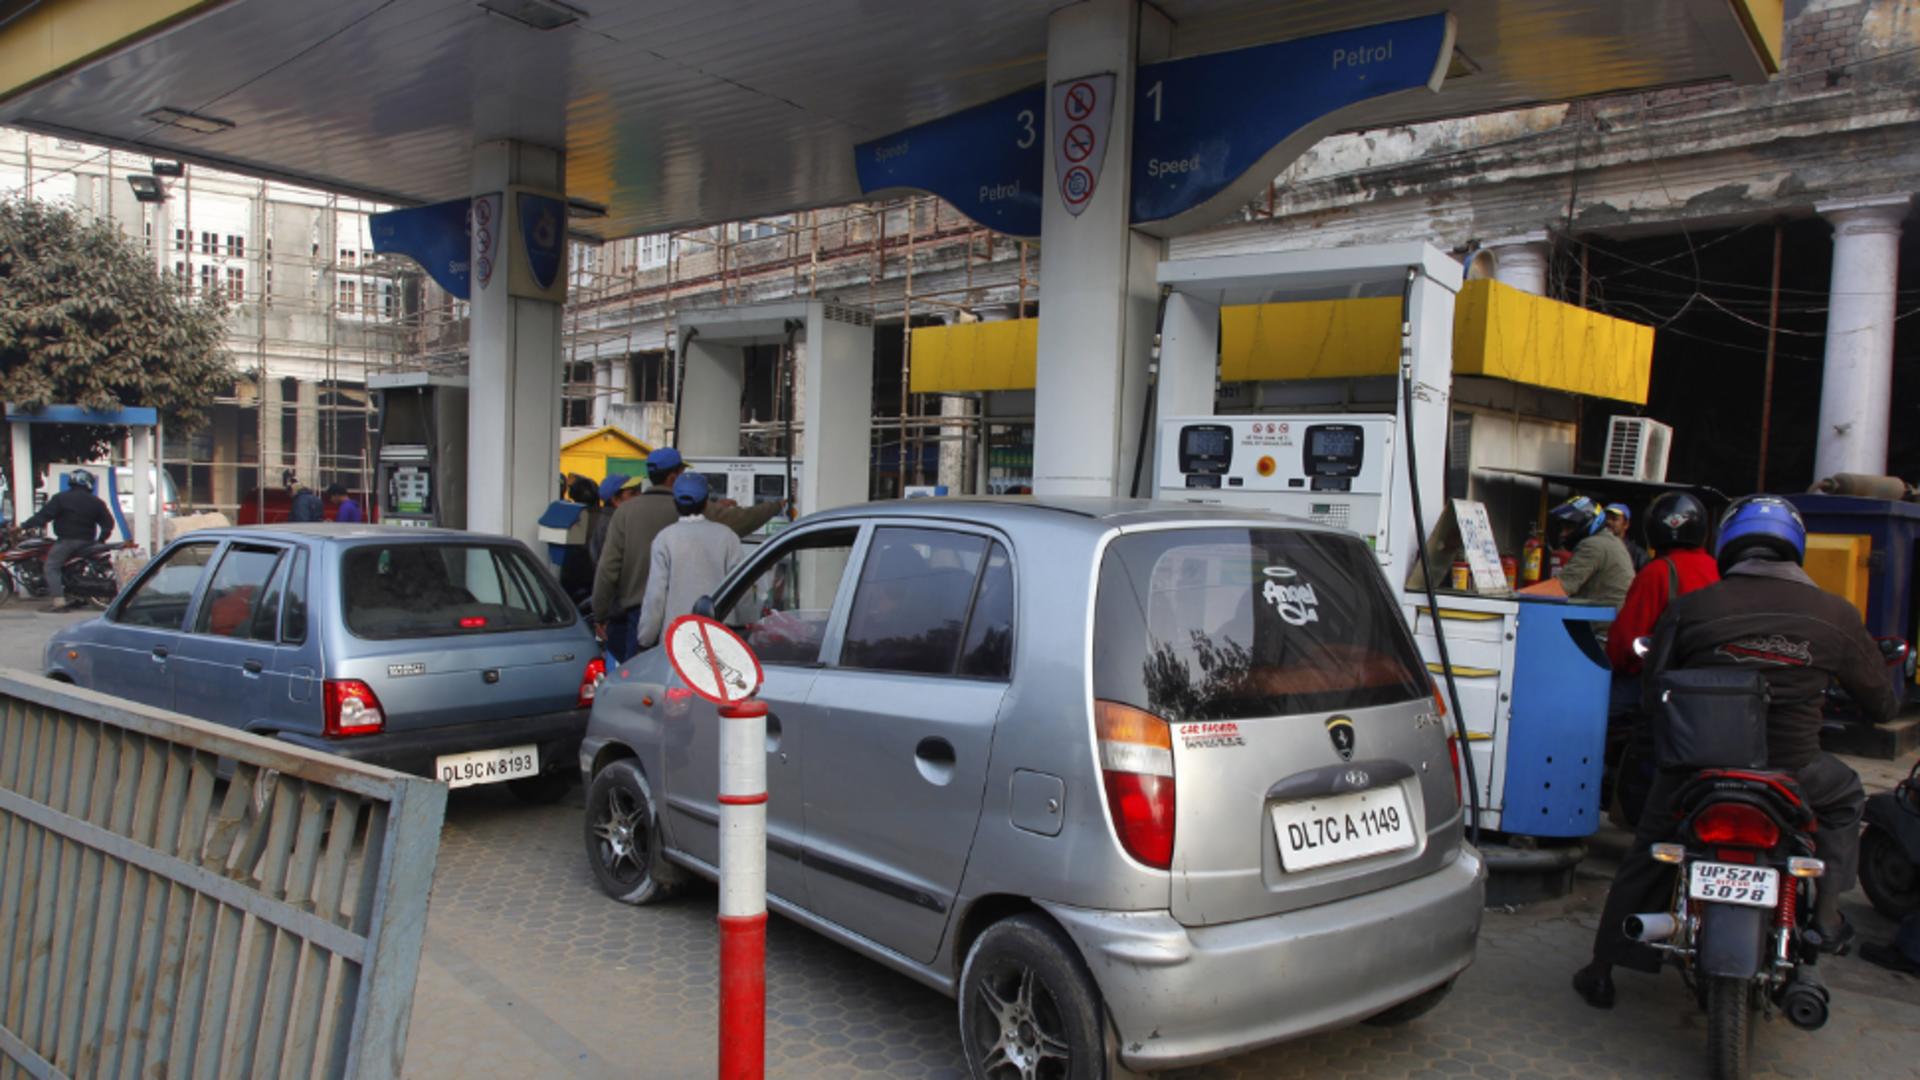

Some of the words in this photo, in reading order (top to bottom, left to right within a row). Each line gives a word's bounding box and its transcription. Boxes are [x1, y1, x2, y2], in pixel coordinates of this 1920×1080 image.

[1332, 39, 1393, 70] Petrol
[1146, 80, 1163, 122] 1
[1016, 109, 1036, 149] 3
[1147, 153, 1200, 178] Speed
[979, 181, 1020, 203] Petrol
